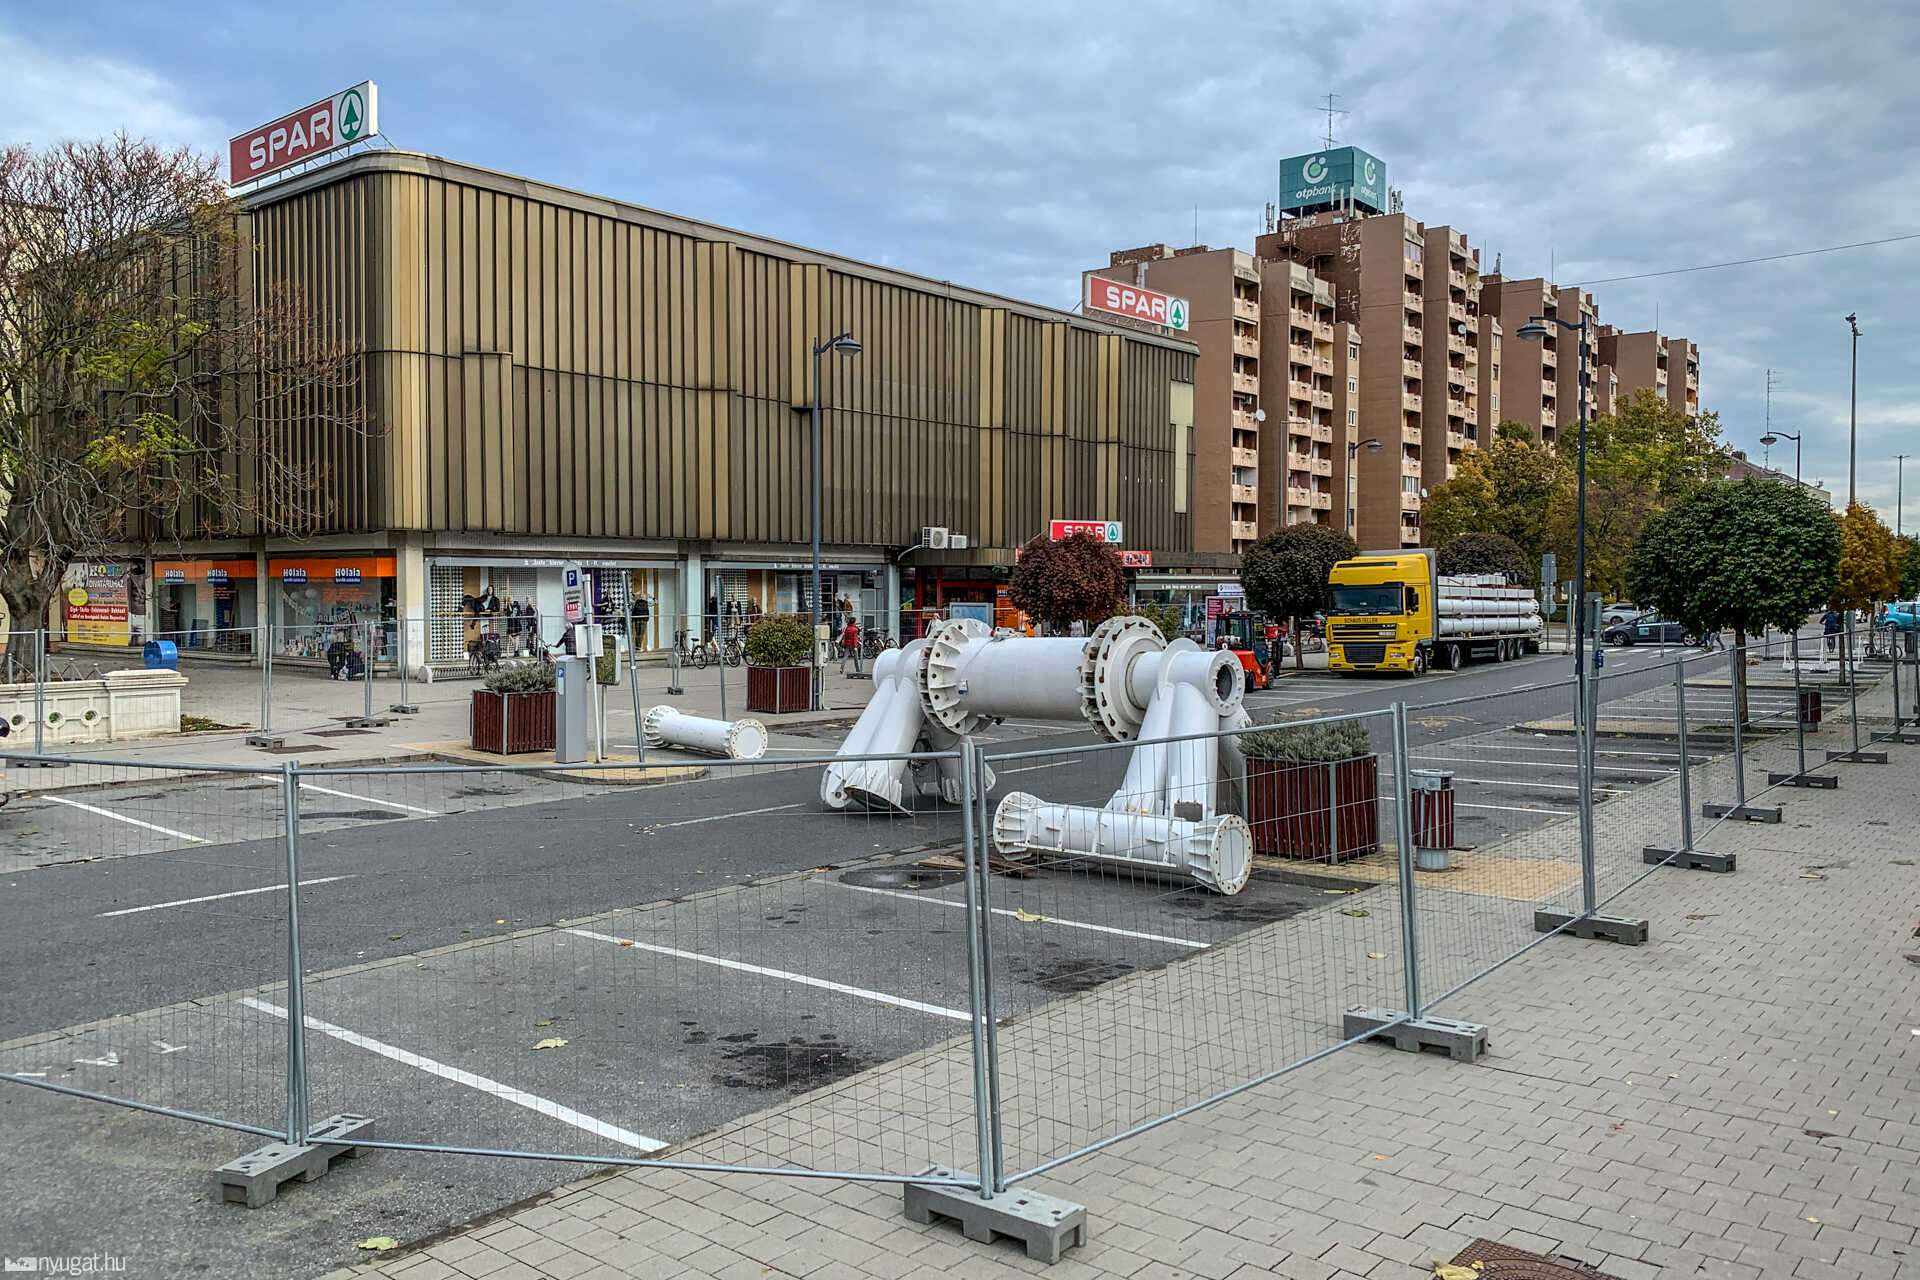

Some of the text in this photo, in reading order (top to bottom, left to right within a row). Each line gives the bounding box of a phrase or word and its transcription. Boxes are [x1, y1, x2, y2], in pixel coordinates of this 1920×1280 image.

[249, 109, 331, 170] SPAR
[1295, 183, 1337, 200] otpbank
[1106, 286, 1166, 320] SPAR
[568, 572, 575, 585] P
